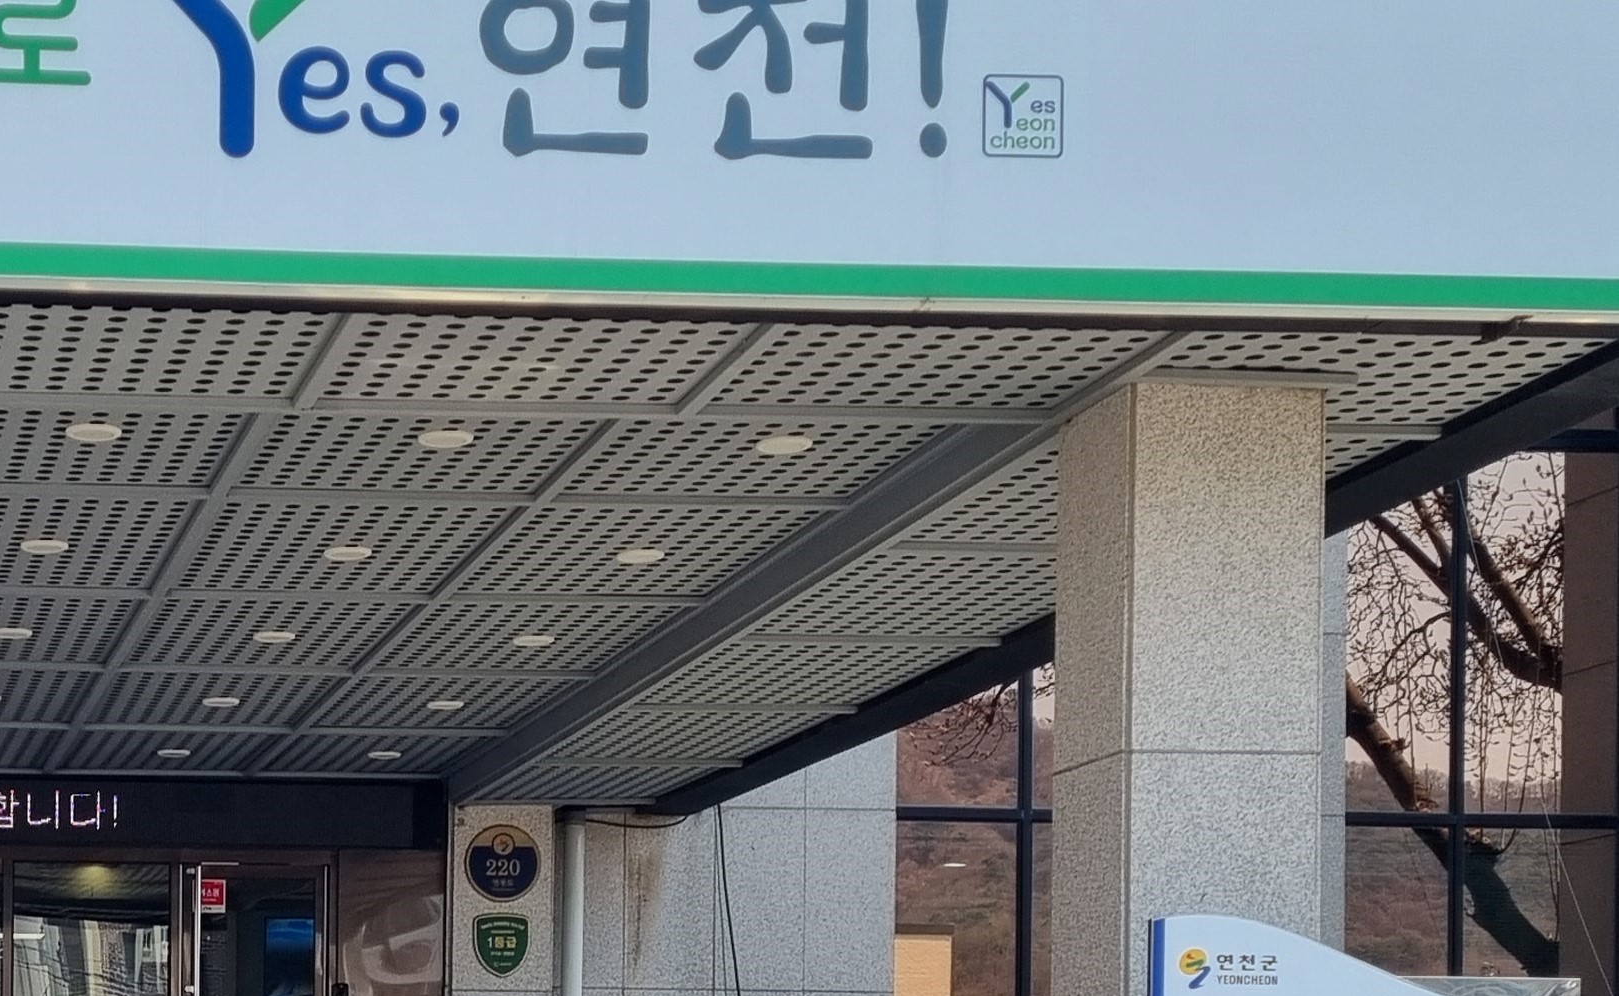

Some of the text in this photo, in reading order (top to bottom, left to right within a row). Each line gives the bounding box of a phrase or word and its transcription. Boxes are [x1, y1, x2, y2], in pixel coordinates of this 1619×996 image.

[989, 130, 1056, 150] cheon
[485, 858, 521, 876] 220
[1216, 953, 1279, 972] 연천군
[1216, 974, 1279, 986] YEONCHEON
